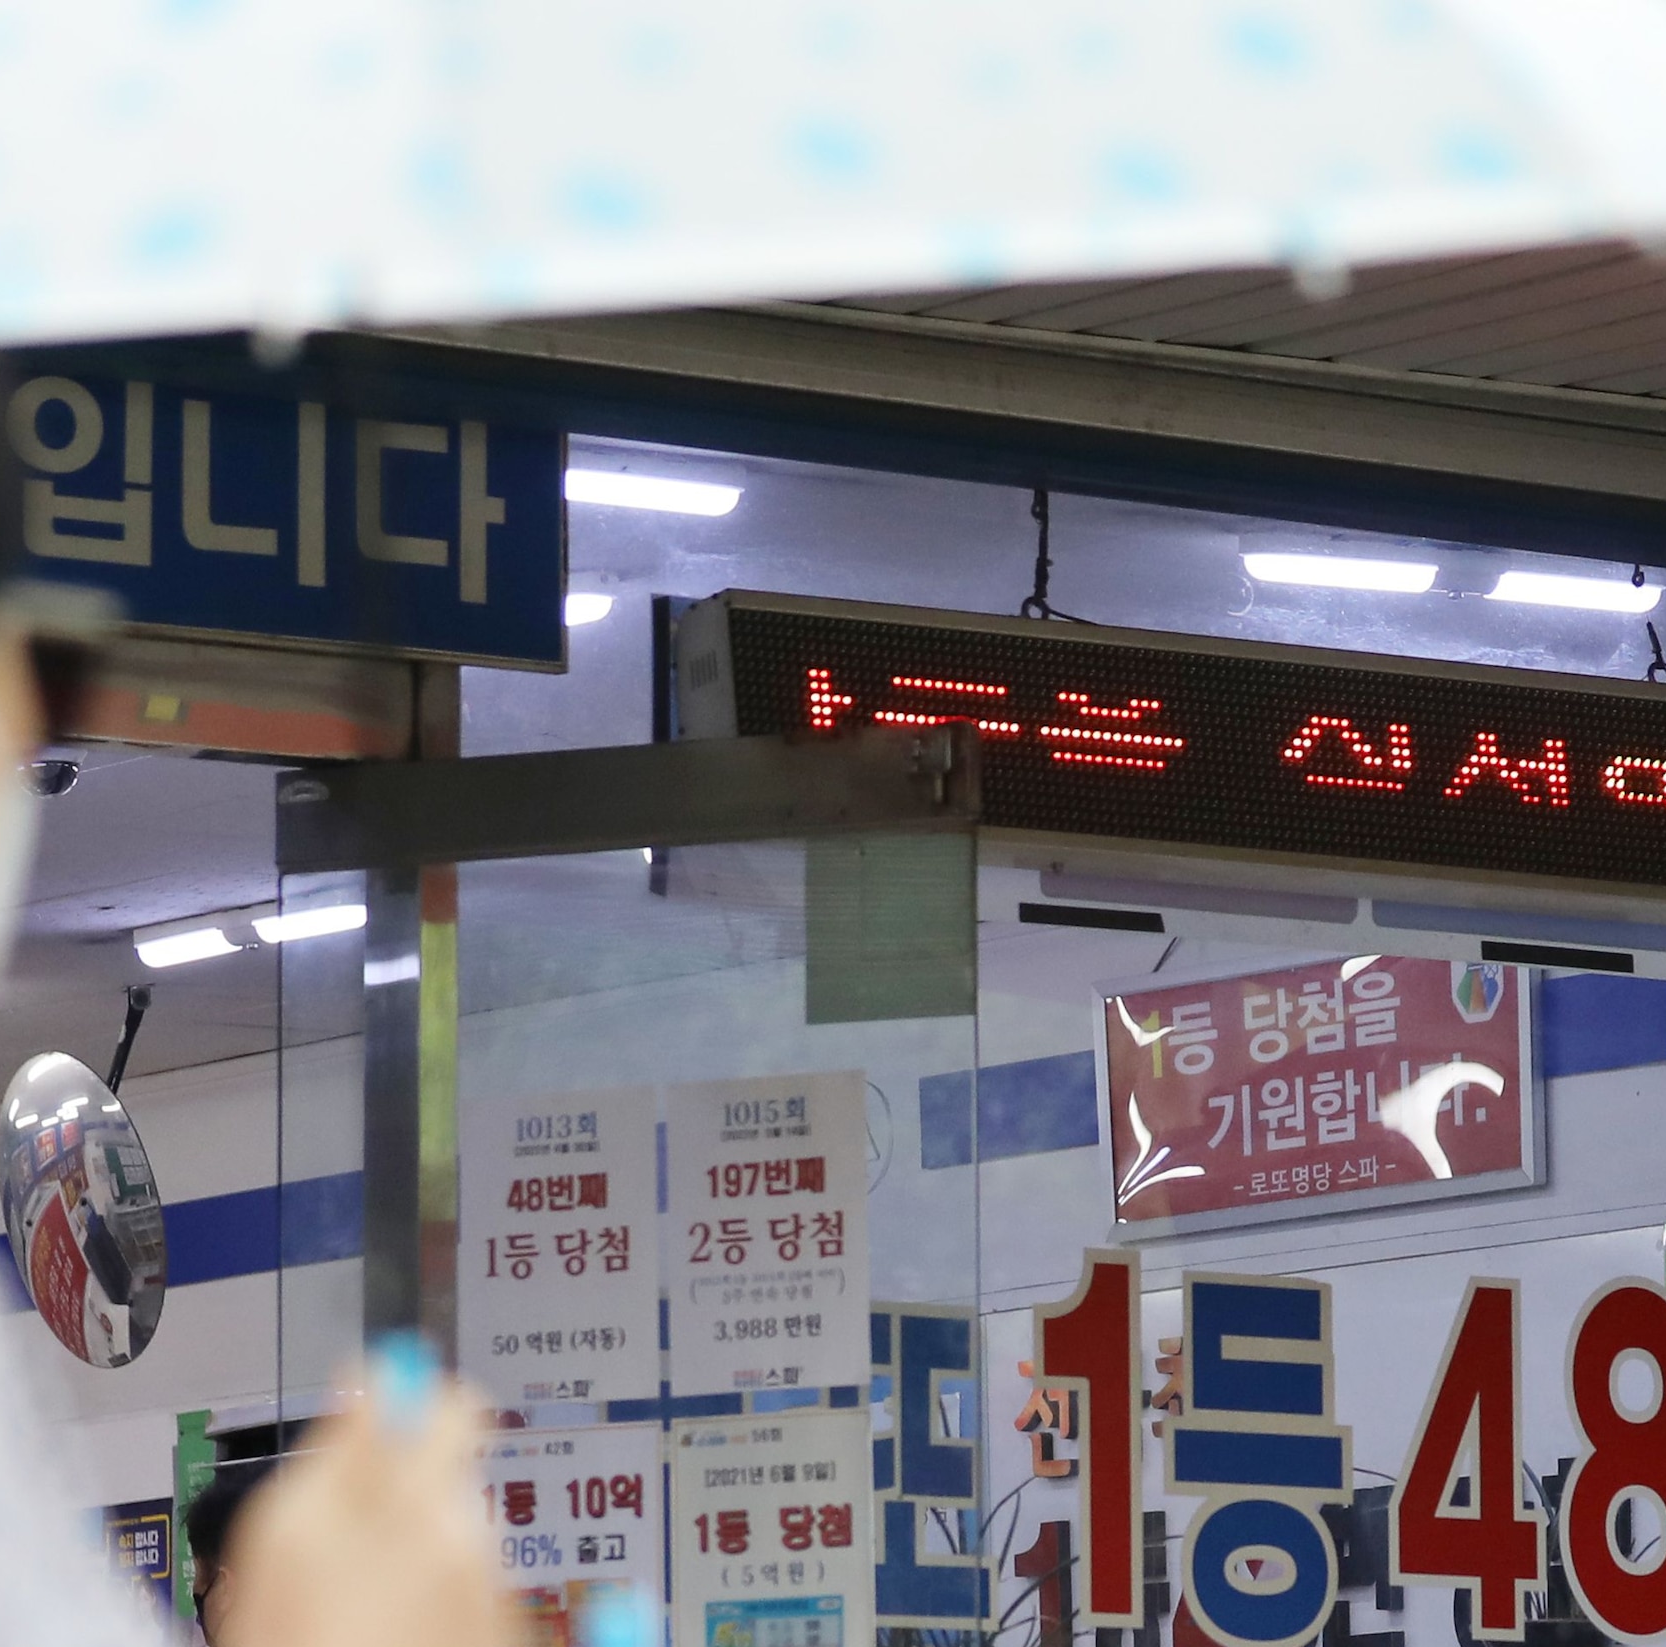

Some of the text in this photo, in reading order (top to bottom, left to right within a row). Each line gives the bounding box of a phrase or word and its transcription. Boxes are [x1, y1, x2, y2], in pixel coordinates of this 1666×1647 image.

[1243, 971, 1401, 1064] 당첨을
[507, 1171, 608, 1213] 48번째
[707, 1156, 825, 1198] 197번째
[1339, 1155, 1380, 1186] 스파
[486, 1225, 630, 1280] 1등 당첨
[688, 1210, 845, 1265] 2등 당첨
[567, 1473, 643, 1519] 10억
[694, 1502, 853, 1555] 1등 당첨
